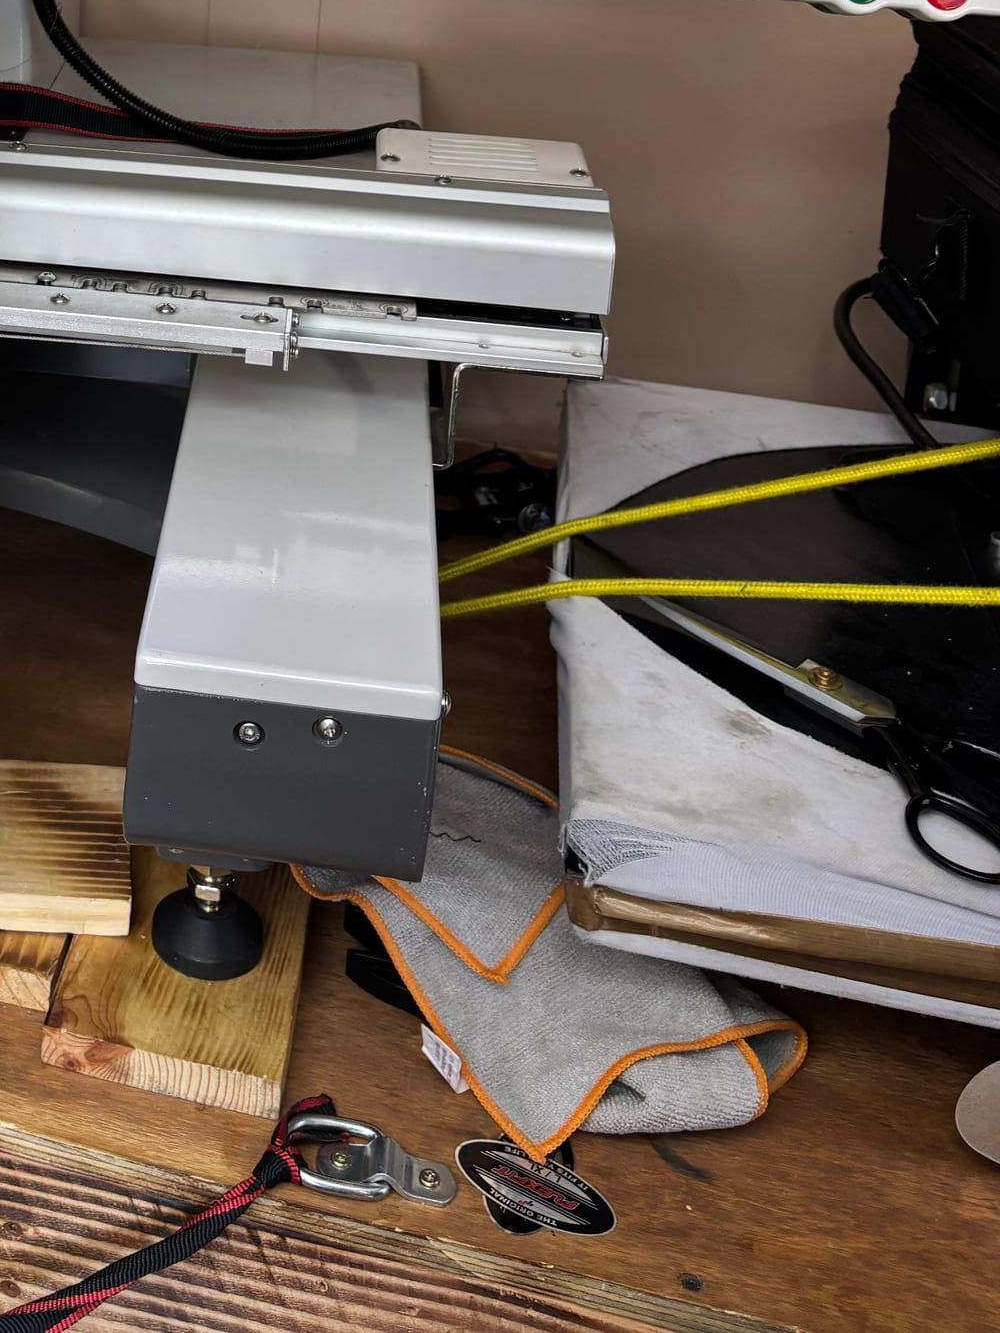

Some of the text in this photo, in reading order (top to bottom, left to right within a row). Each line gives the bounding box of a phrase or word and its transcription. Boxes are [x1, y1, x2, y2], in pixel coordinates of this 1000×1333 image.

[503, 1145, 526, 1157] LIFE
[488, 1187, 558, 1226] THE ORIGINAL
[490, 1164, 580, 1211] FLEXFIT
